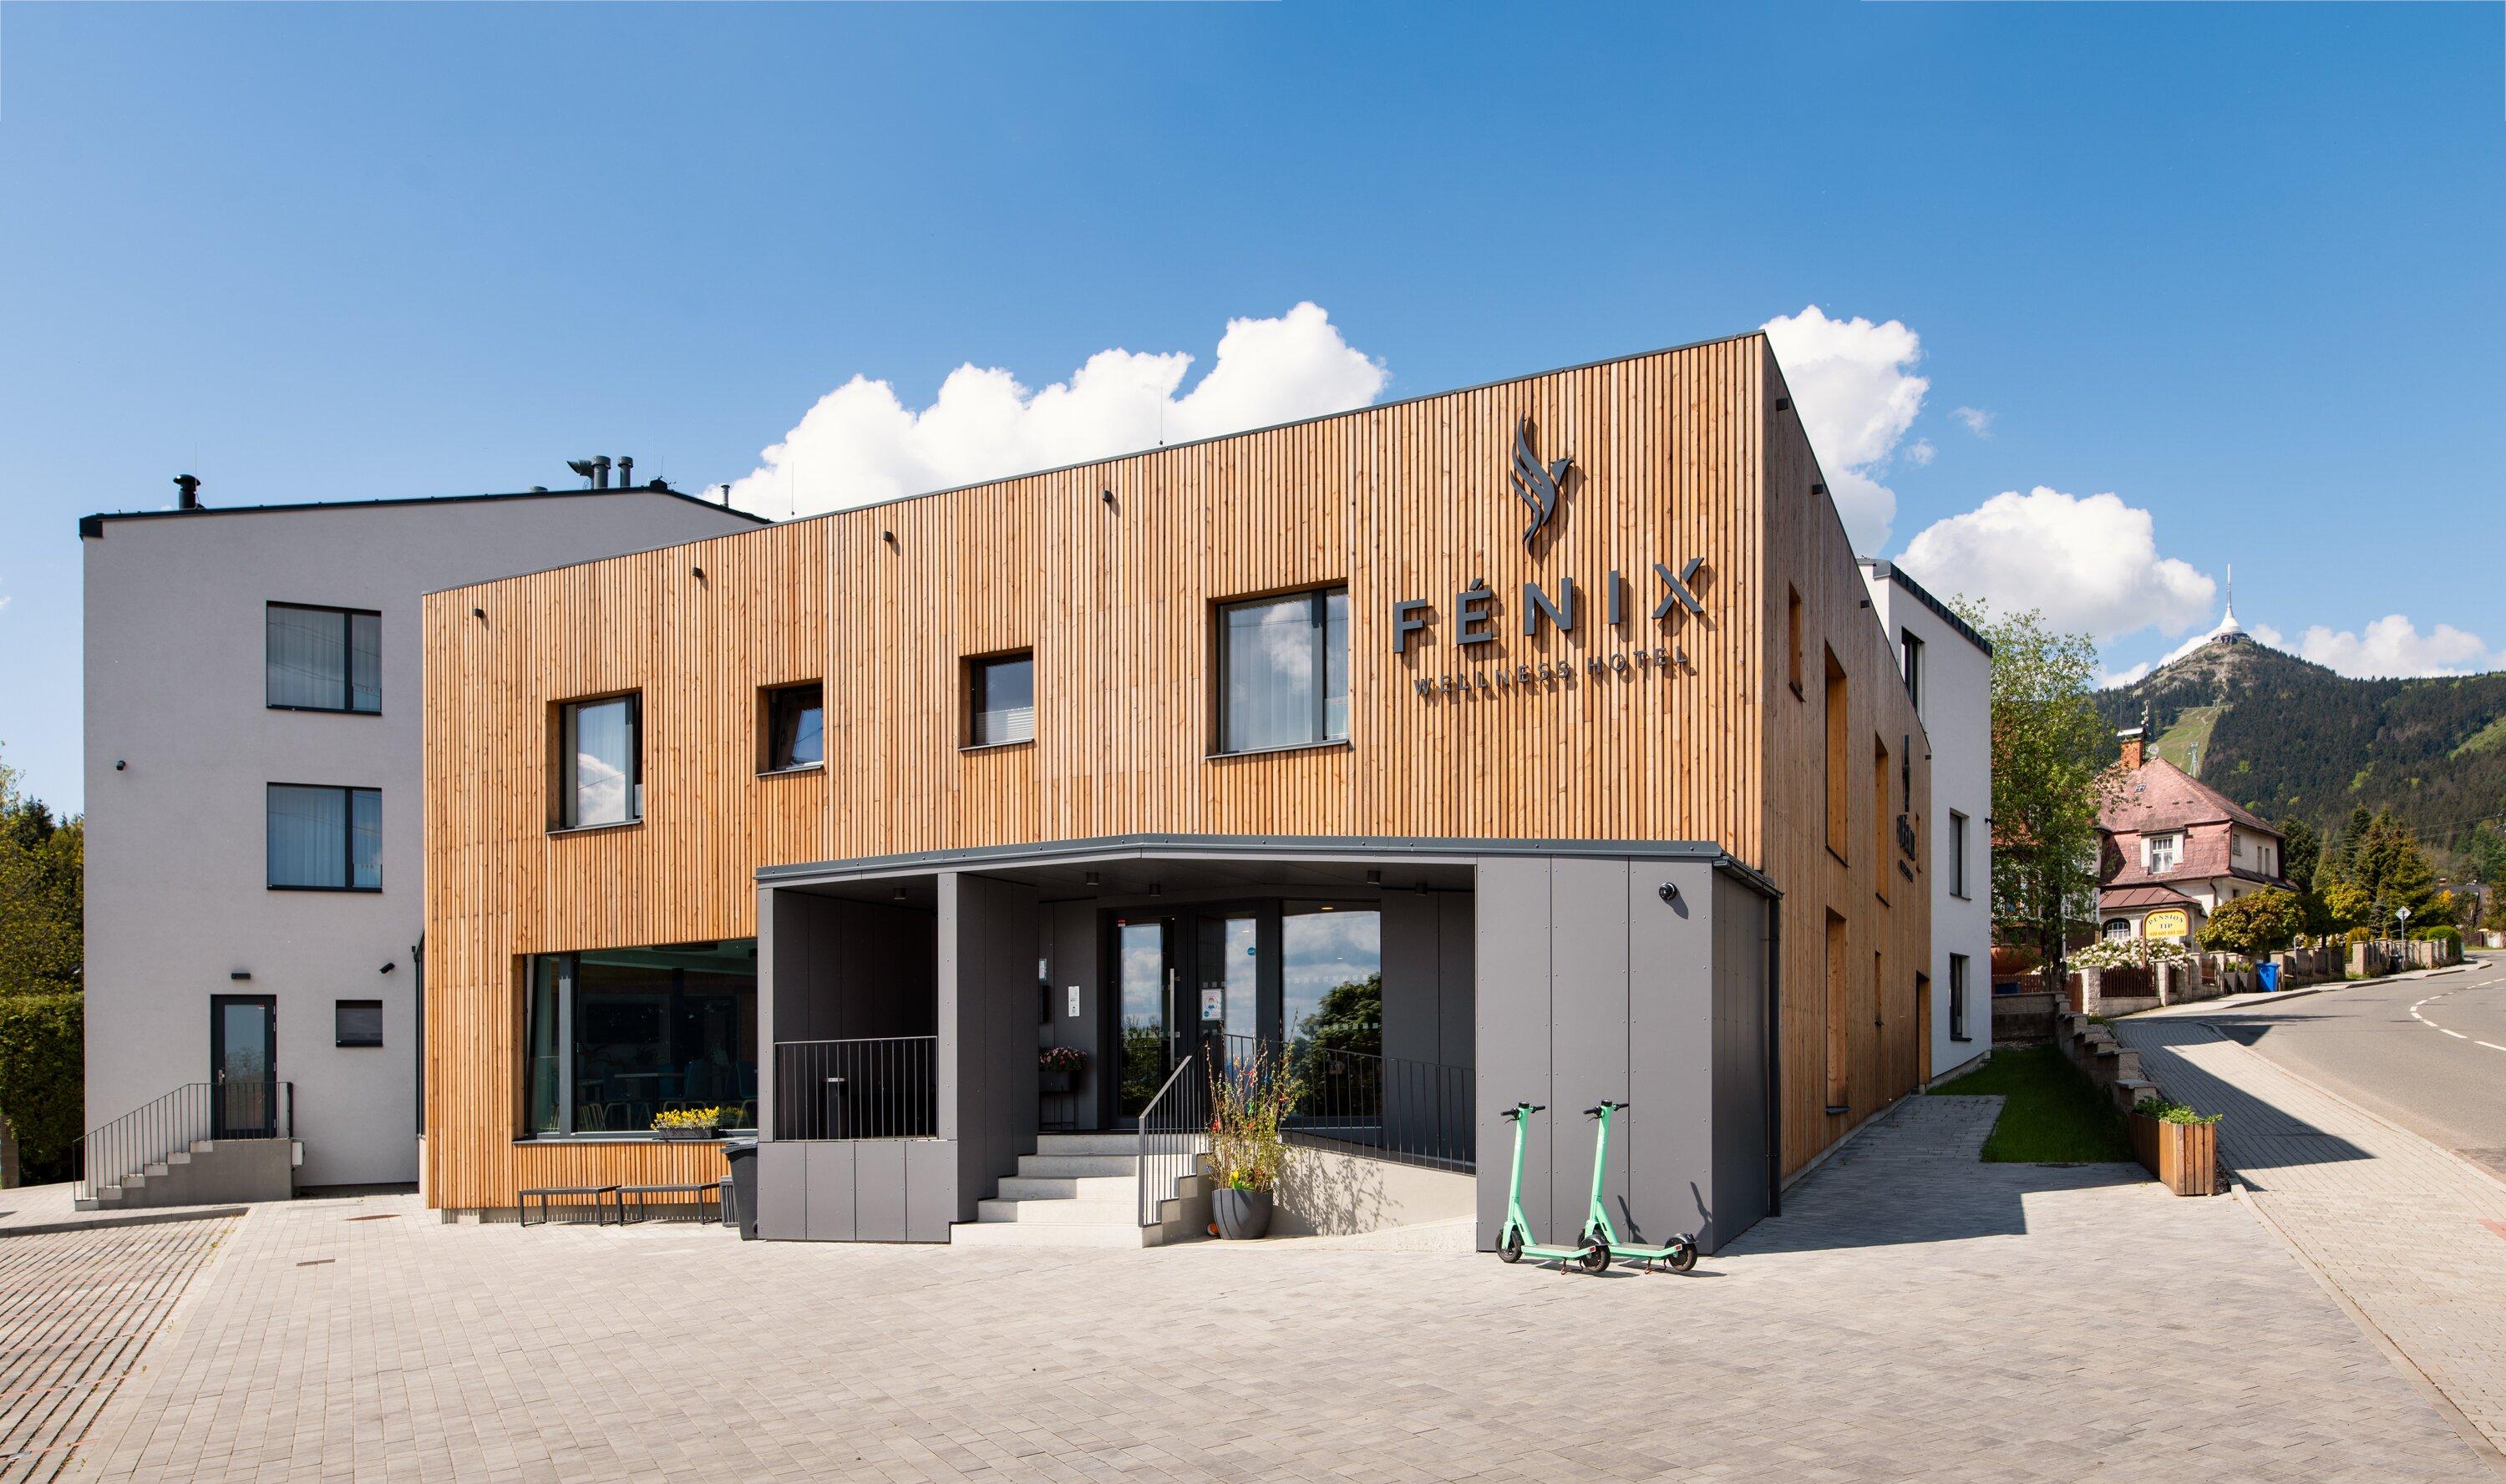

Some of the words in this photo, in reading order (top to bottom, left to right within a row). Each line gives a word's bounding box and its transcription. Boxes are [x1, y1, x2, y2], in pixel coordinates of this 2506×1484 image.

[1393, 557, 1705, 653] FÉNIX
[1413, 660, 1570, 696] WELLNESS
[1587, 646, 1688, 675] HOTEL
[2148, 914, 2184, 924] PENSION
